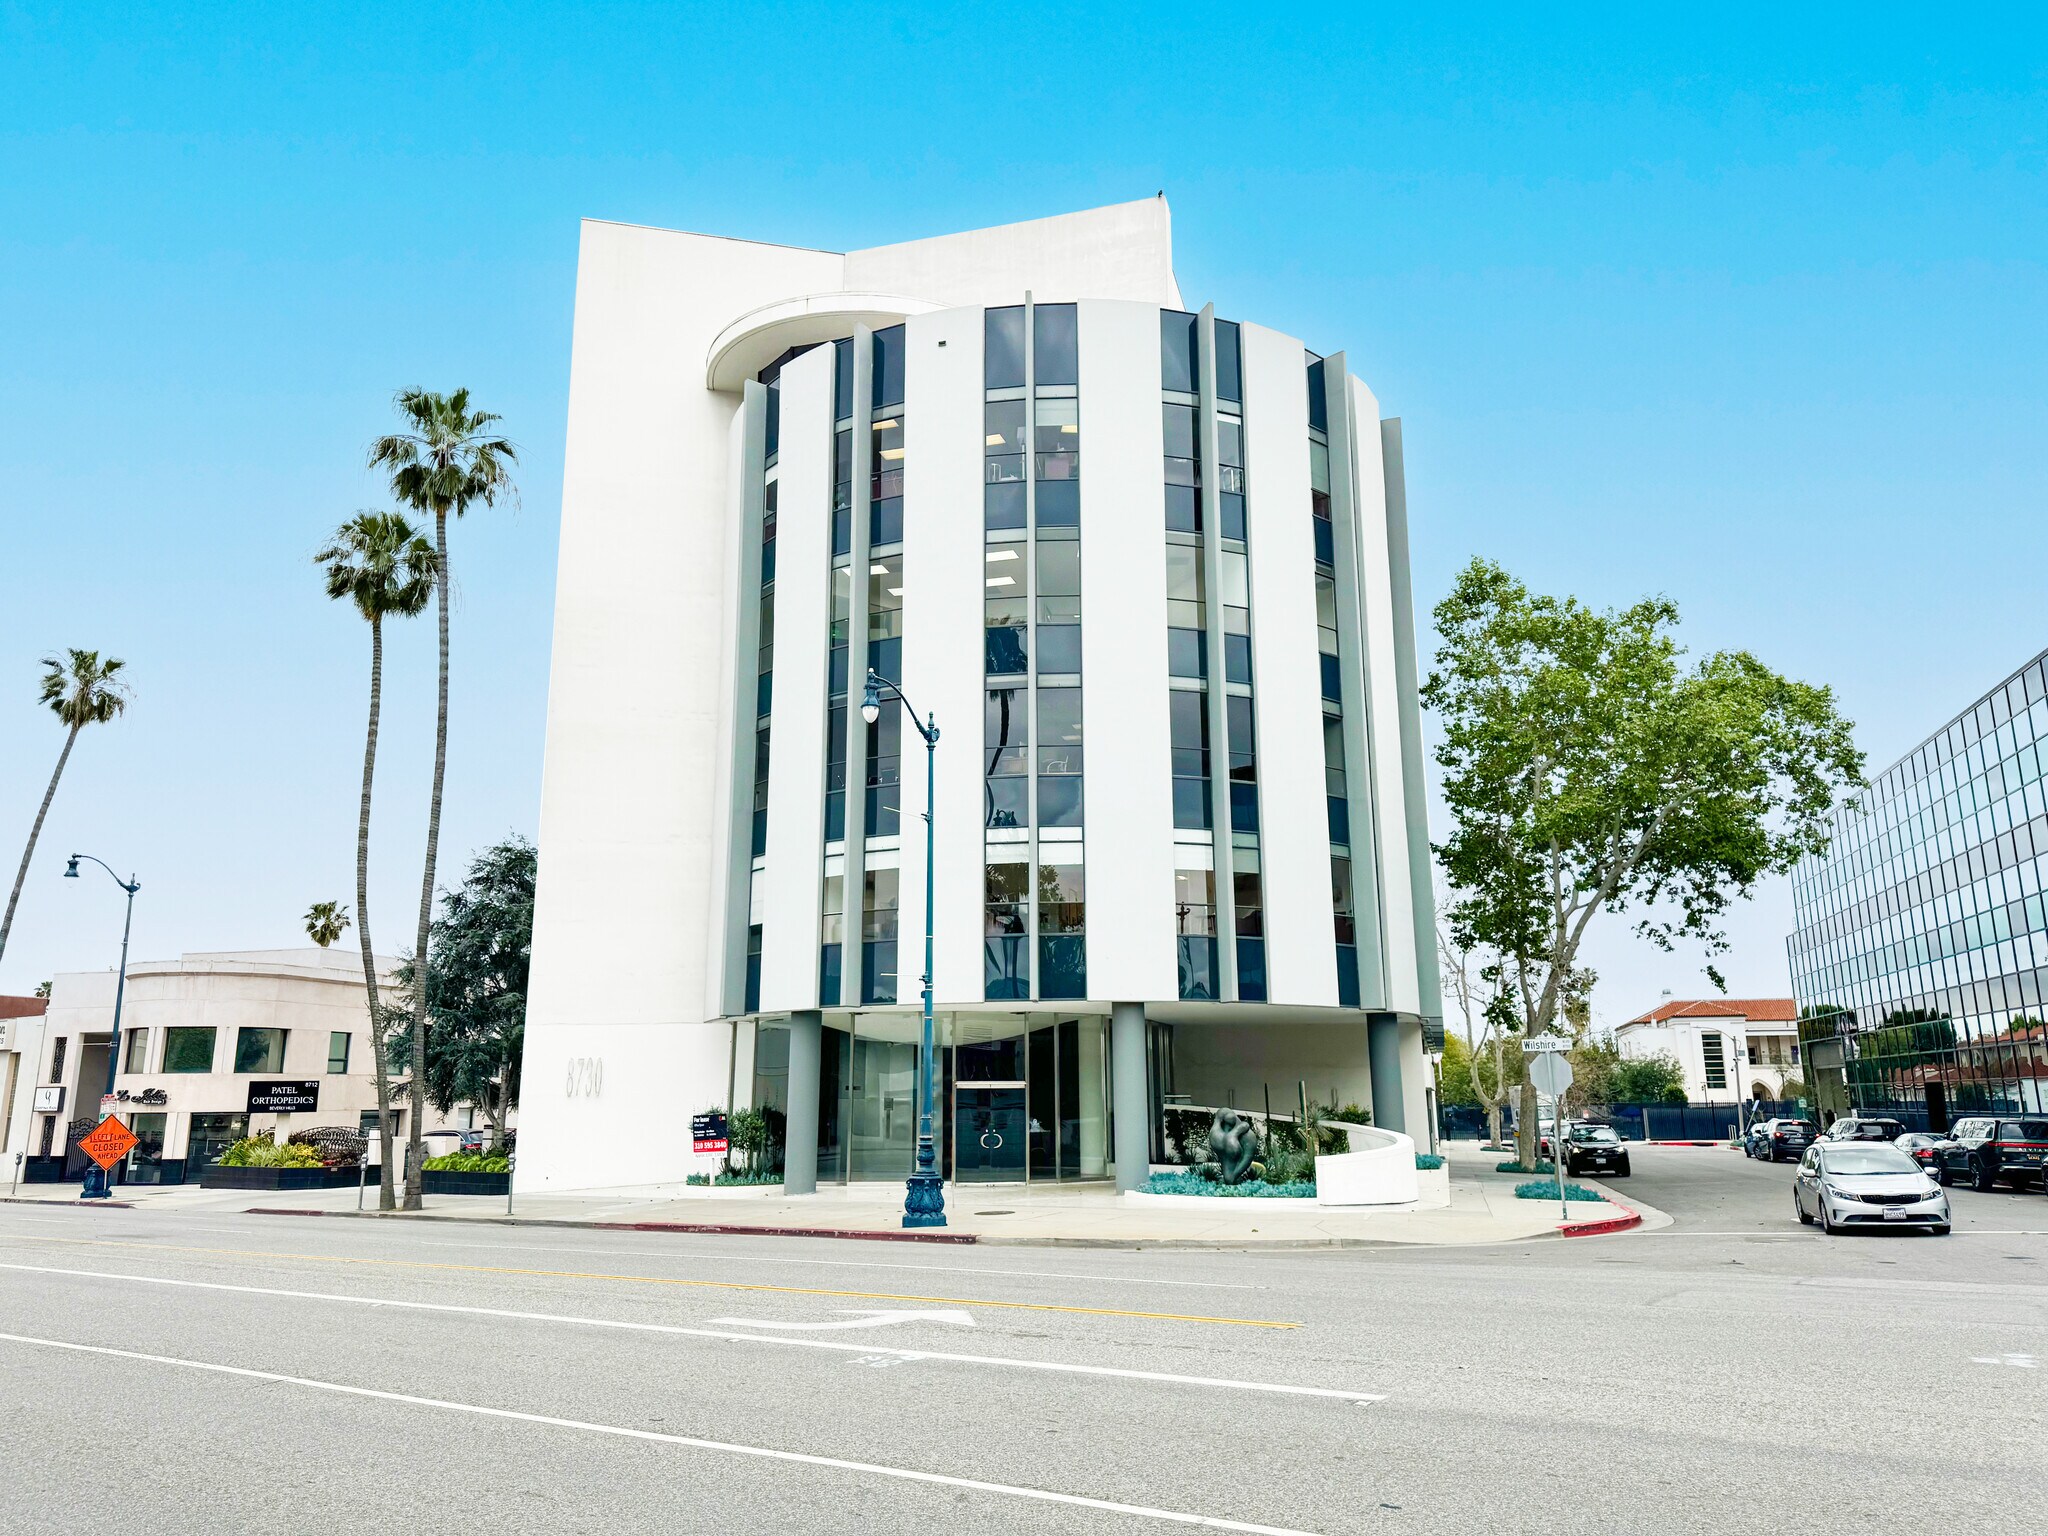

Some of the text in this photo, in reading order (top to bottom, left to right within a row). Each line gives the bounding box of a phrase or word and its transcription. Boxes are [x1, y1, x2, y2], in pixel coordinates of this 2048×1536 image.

[1523, 1040, 1556, 1050] Wilshire
[566, 1056, 603, 1098] 8730
[271, 1086, 298, 1094] PATEL
[252, 1096, 314, 1104] ORTHOPEDICS
[114, 1133, 130, 1141] LANE
[92, 1142, 124, 1152] CLOSED
